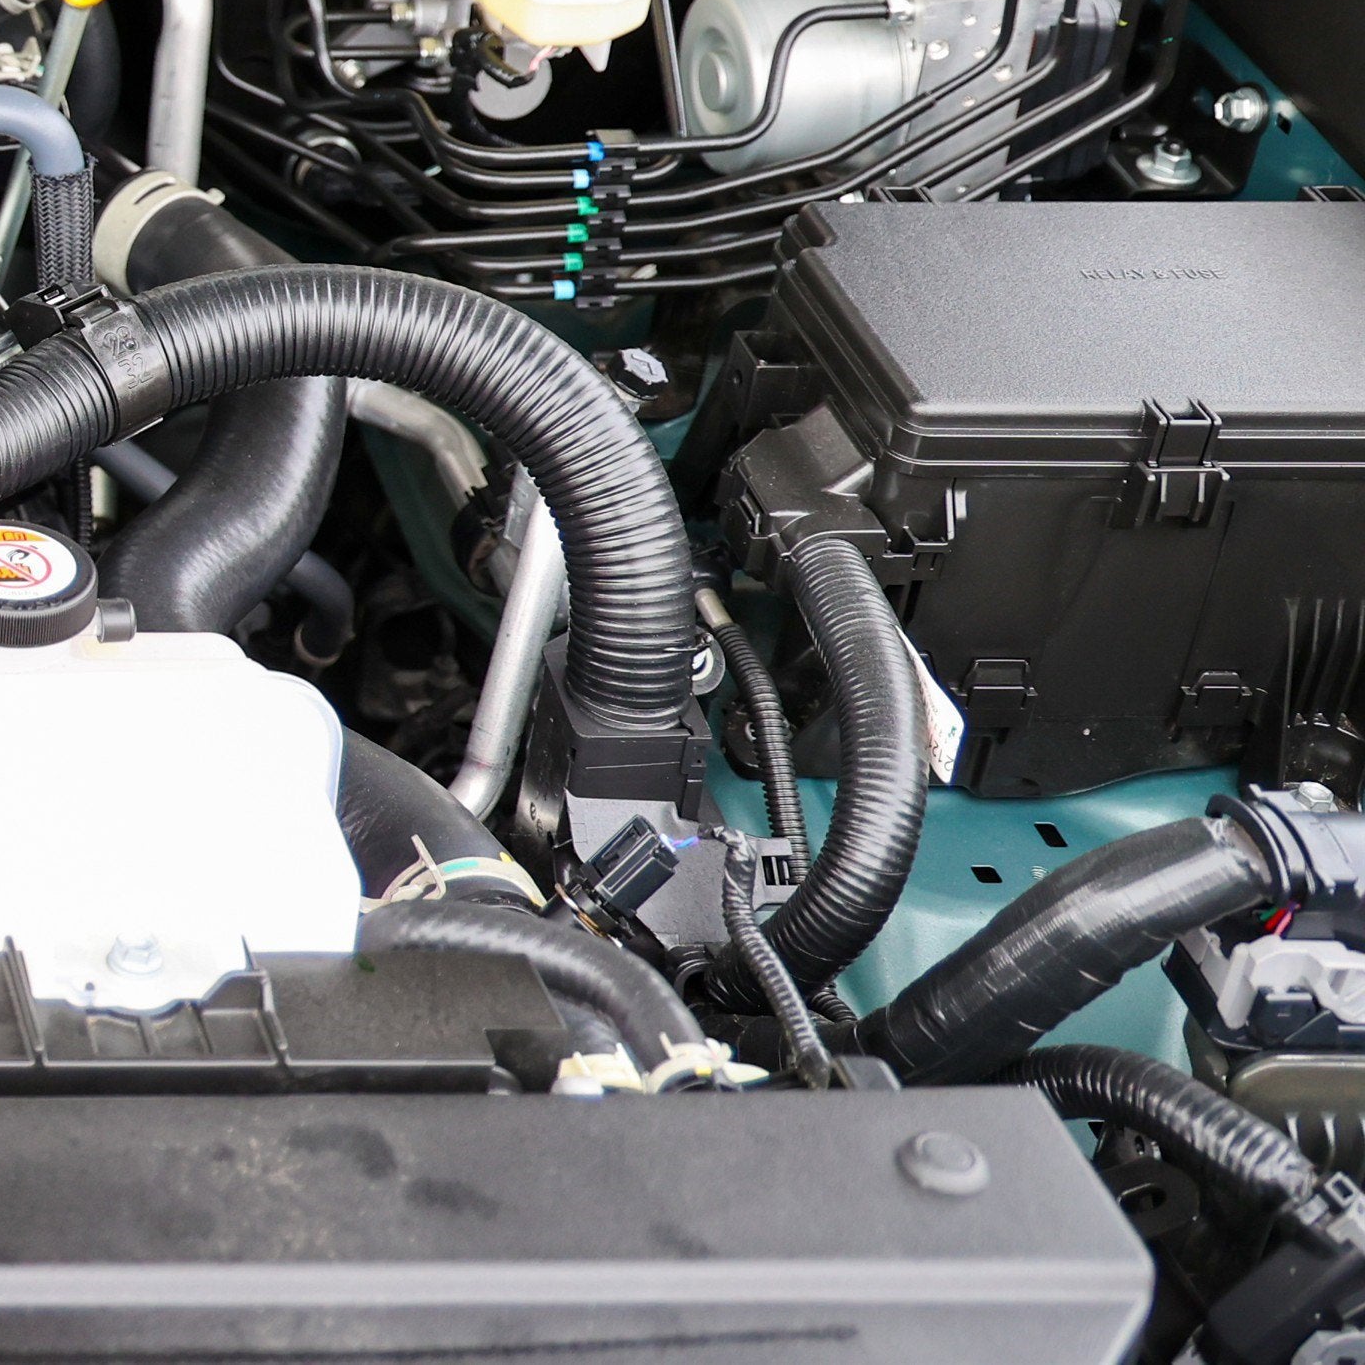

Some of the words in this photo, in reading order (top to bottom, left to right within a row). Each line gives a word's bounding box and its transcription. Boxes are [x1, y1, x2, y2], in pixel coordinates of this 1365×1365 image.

[1080, 268, 1146, 280] RELAY
[1152, 268, 1169, 280] &
[1170, 268, 1229, 280] FUSE
